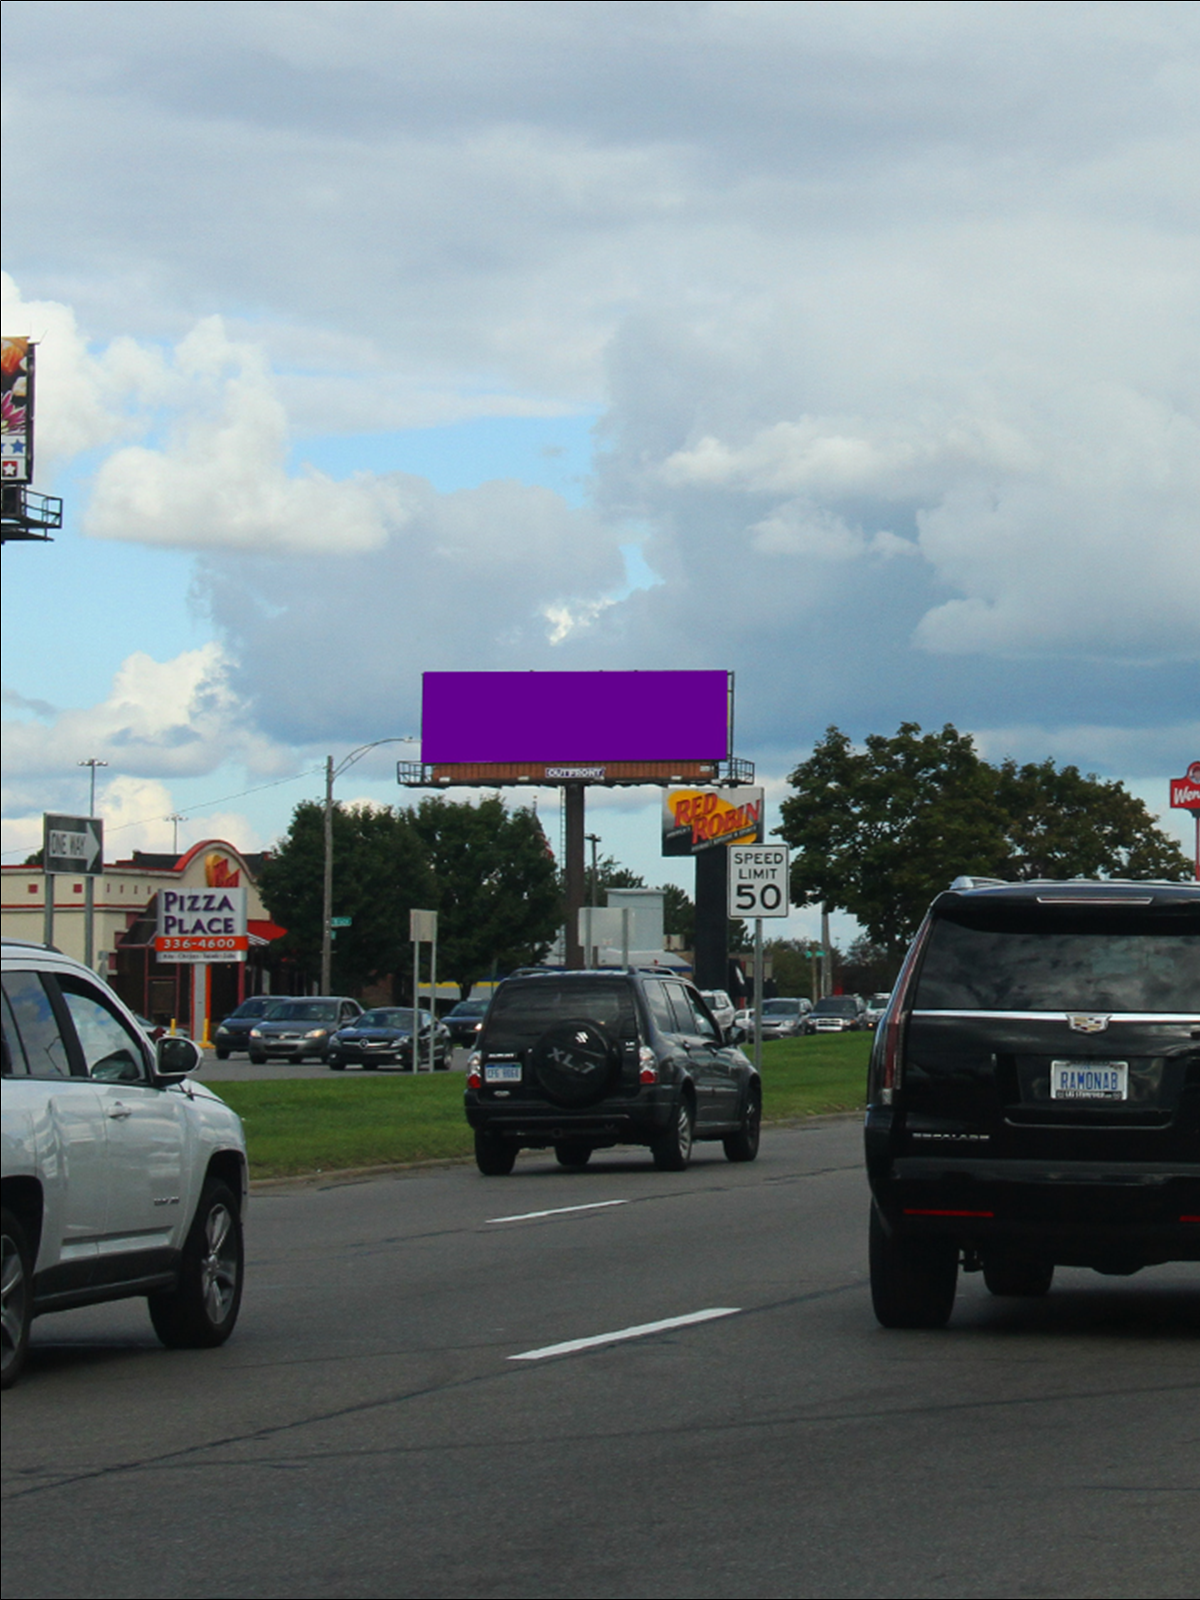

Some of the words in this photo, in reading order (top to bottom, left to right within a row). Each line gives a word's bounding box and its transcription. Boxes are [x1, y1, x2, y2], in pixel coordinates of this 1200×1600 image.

[674, 792, 718, 827] RED
[692, 799, 761, 844] ROBIN
[51, 832, 67, 855] ONE
[70, 834, 86, 857] WAY
[734, 852, 784, 865] SPEED
[738, 868, 778, 880] LIMIT
[164, 891, 235, 912] PIZZA
[736, 883, 782, 910] 50
[164, 915, 235, 935] PLACE
[163, 938, 236, 949] 336-4600
[1061, 1071, 1118, 1090] RAMONAB
